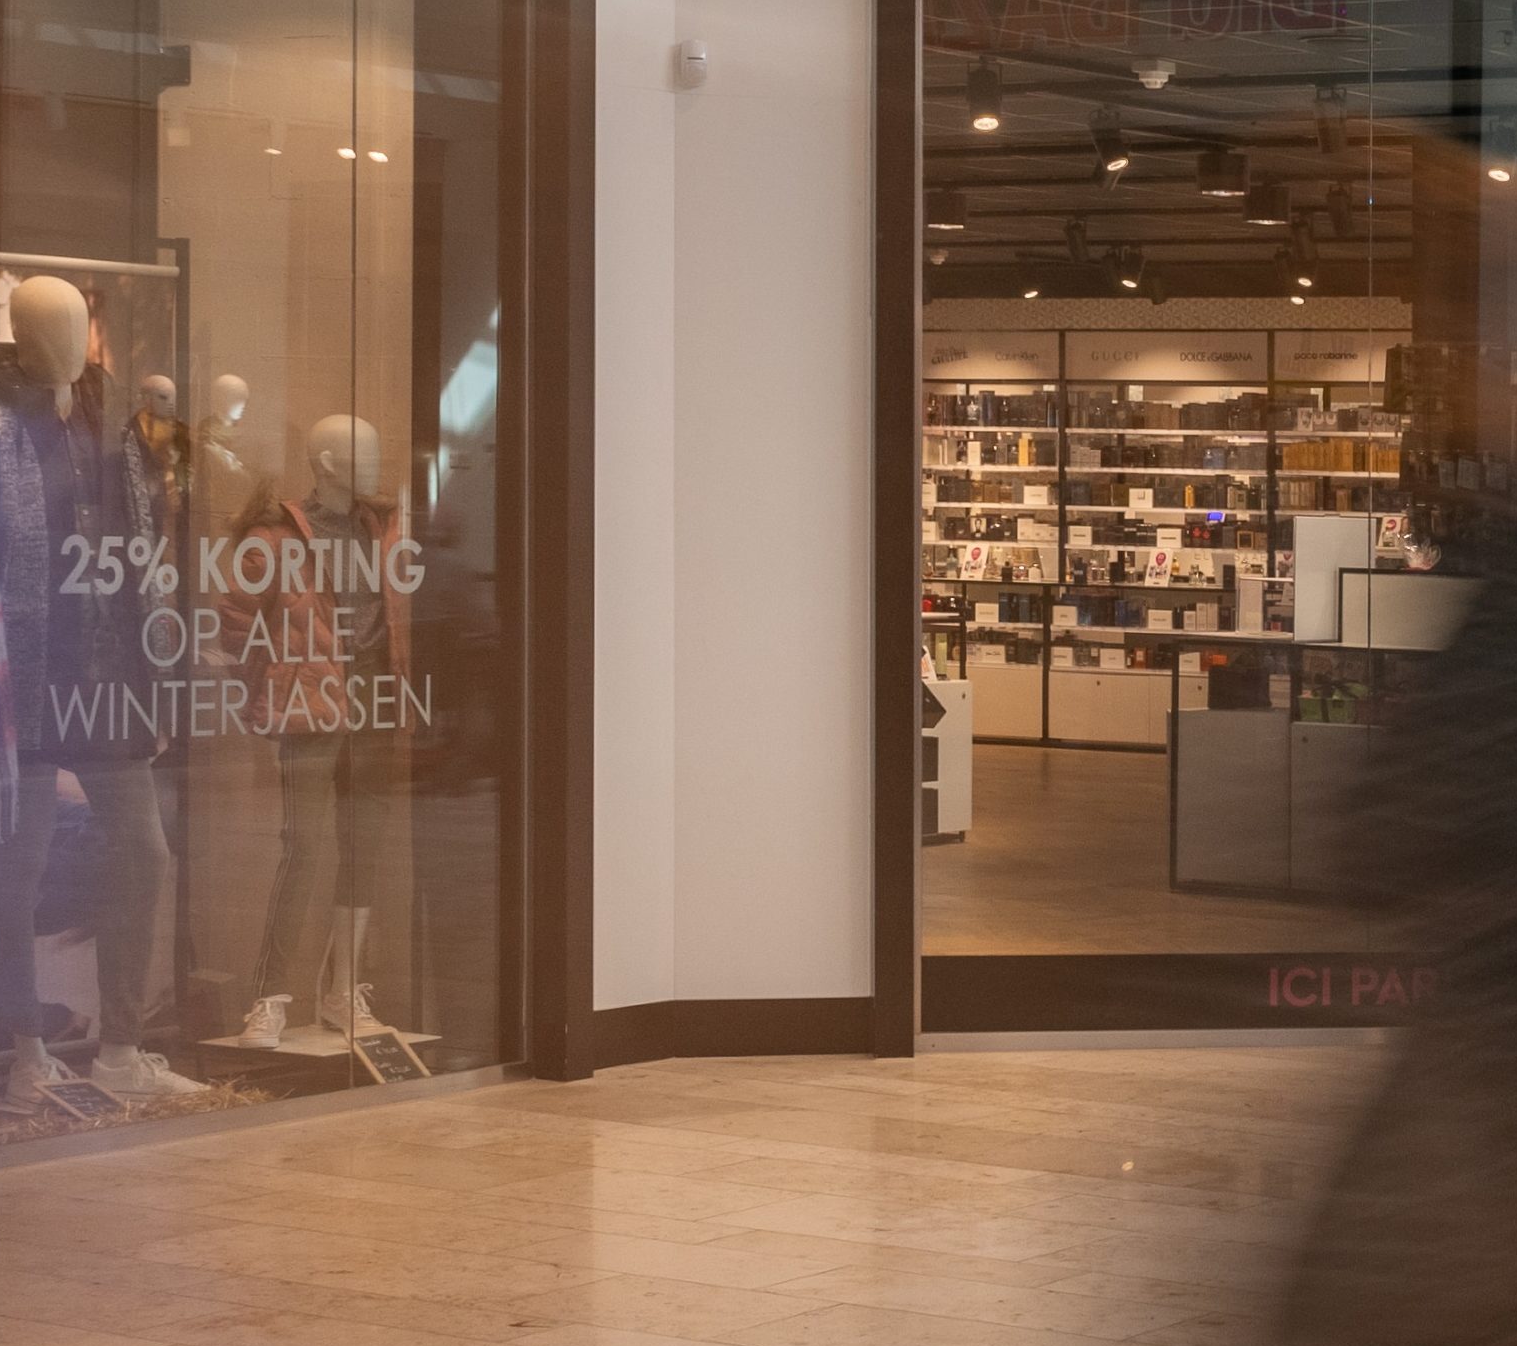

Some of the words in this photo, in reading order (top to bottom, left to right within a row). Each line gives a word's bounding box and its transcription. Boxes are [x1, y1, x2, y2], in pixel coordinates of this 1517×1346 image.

[1091, 351, 1140, 361] GUCCI
[59, 534, 180, 595] 25%
[199, 535, 427, 596] KORTING
[141, 606, 222, 667] OP
[239, 607, 356, 665] ALLE
[48, 673, 433, 744] WINTERJASSEN
[1268, 966, 1332, 1007] ICI
[1350, 966, 1435, 1007] PAR
